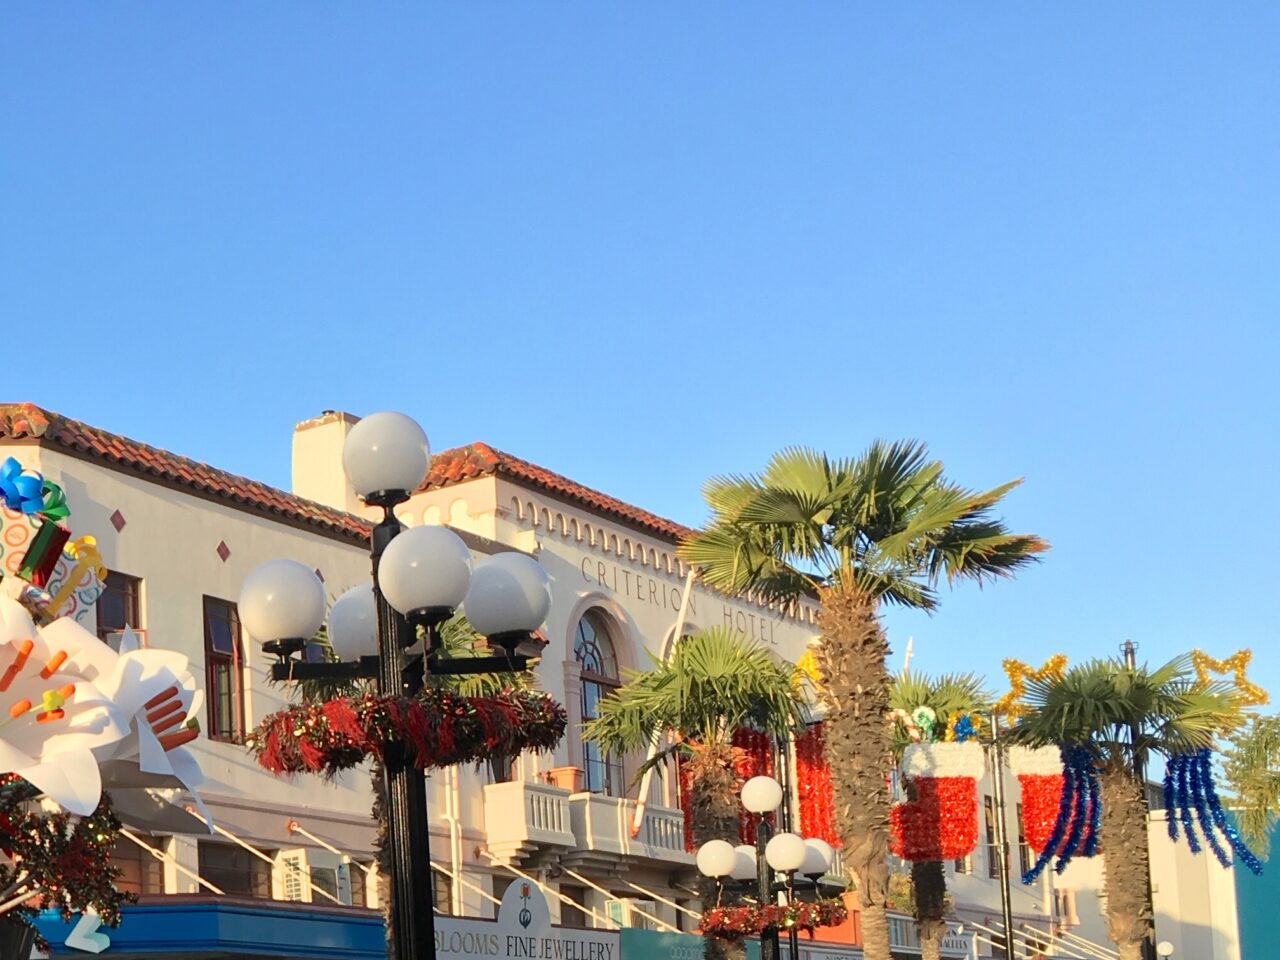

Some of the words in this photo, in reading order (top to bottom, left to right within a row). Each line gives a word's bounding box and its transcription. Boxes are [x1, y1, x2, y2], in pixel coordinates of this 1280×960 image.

[582, 556, 697, 616] CRITERION
[723, 604, 778, 646] HOTEL
[434, 930, 499, 956] BLOOMS
[506, 935, 538, 959] FINE
